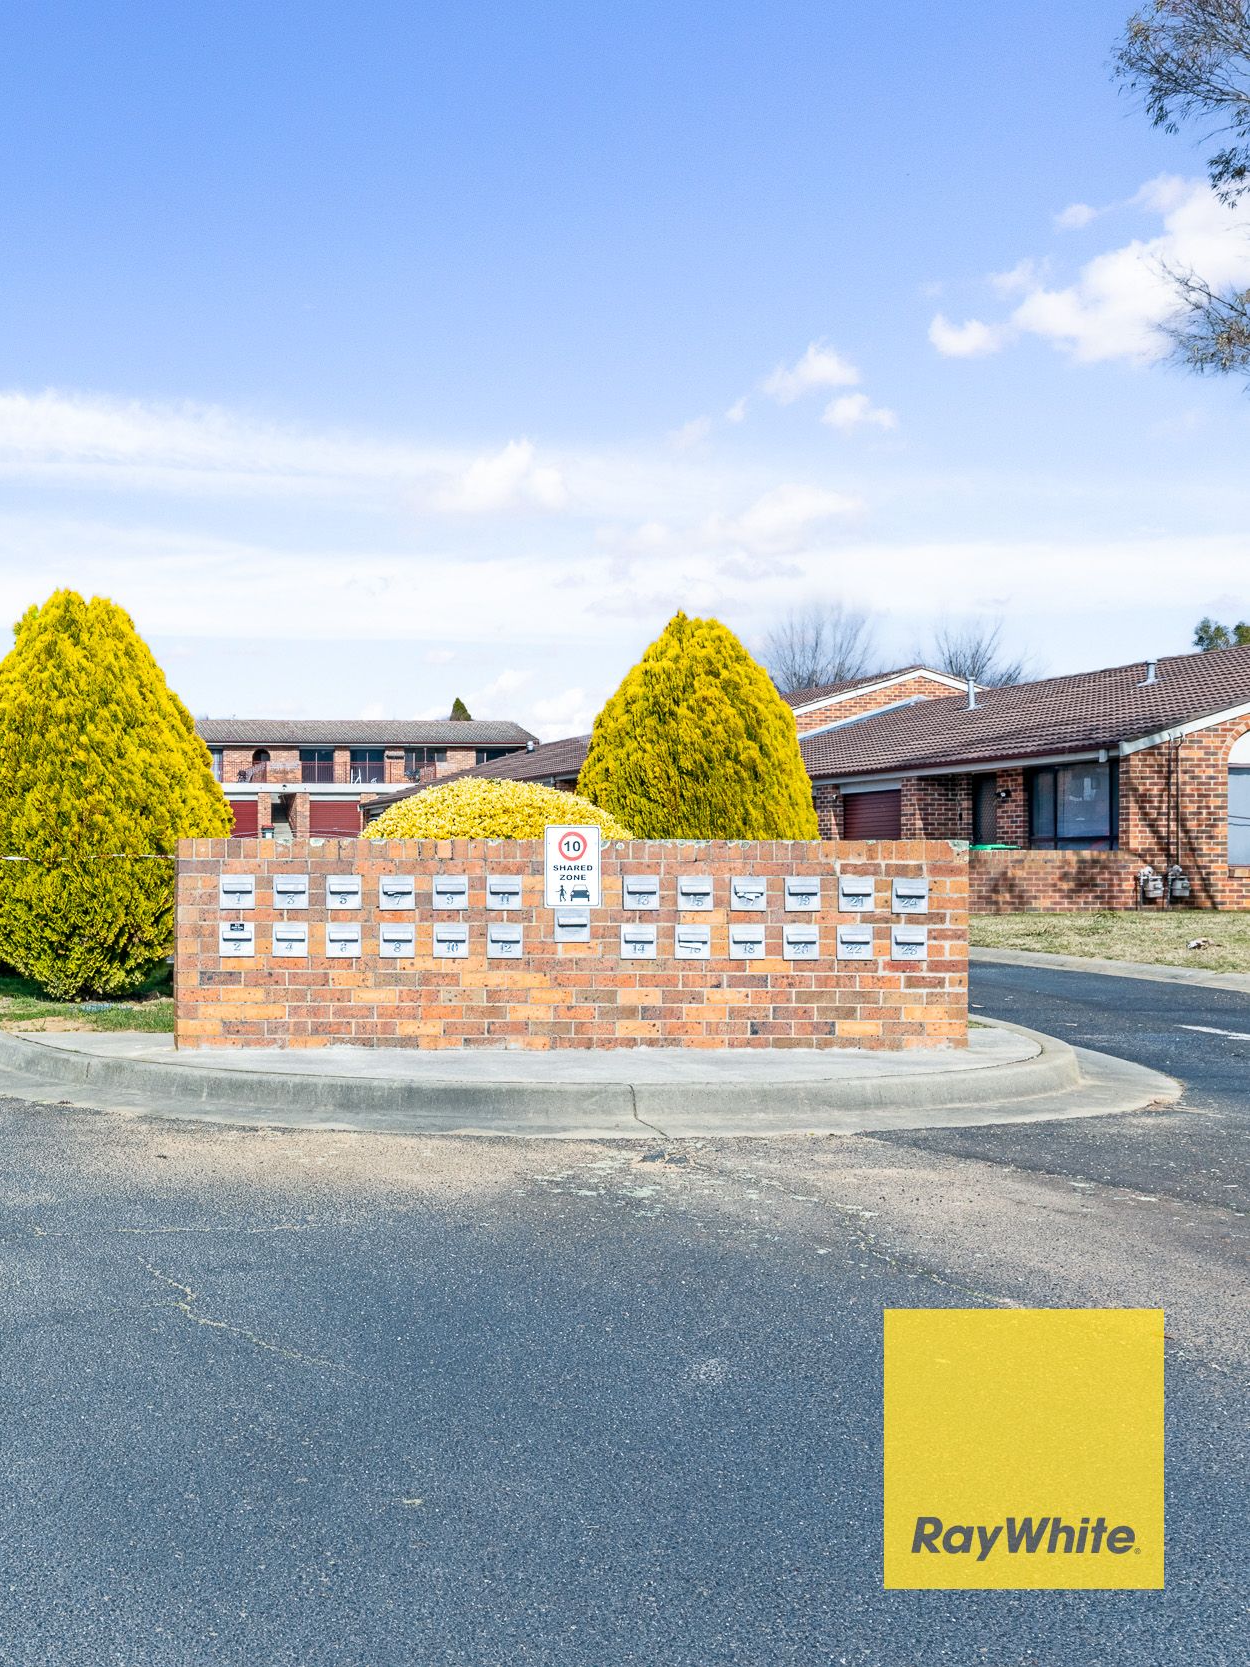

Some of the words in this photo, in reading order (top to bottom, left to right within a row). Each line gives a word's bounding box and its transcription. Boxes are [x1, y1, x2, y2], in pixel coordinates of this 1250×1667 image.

[564, 841, 581, 852] 10
[286, 893, 295, 905] 3
[339, 893, 348, 905] 5
[392, 894, 402, 905] 7
[445, 893, 454, 905] 9
[498, 894, 510, 905] 11
[690, 895, 704, 907] 15
[850, 896, 864, 908] 21
[901, 897, 917, 909] 24
[233, 942, 242, 952] 2
[285, 942, 293, 952] 4
[339, 942, 348, 953] 6
[393, 942, 402, 953] 8
[446, 942, 459, 954] 10
[499, 942, 512, 954] 12
[632, 943, 645, 954] 14
[846, 944, 862, 955] 22
